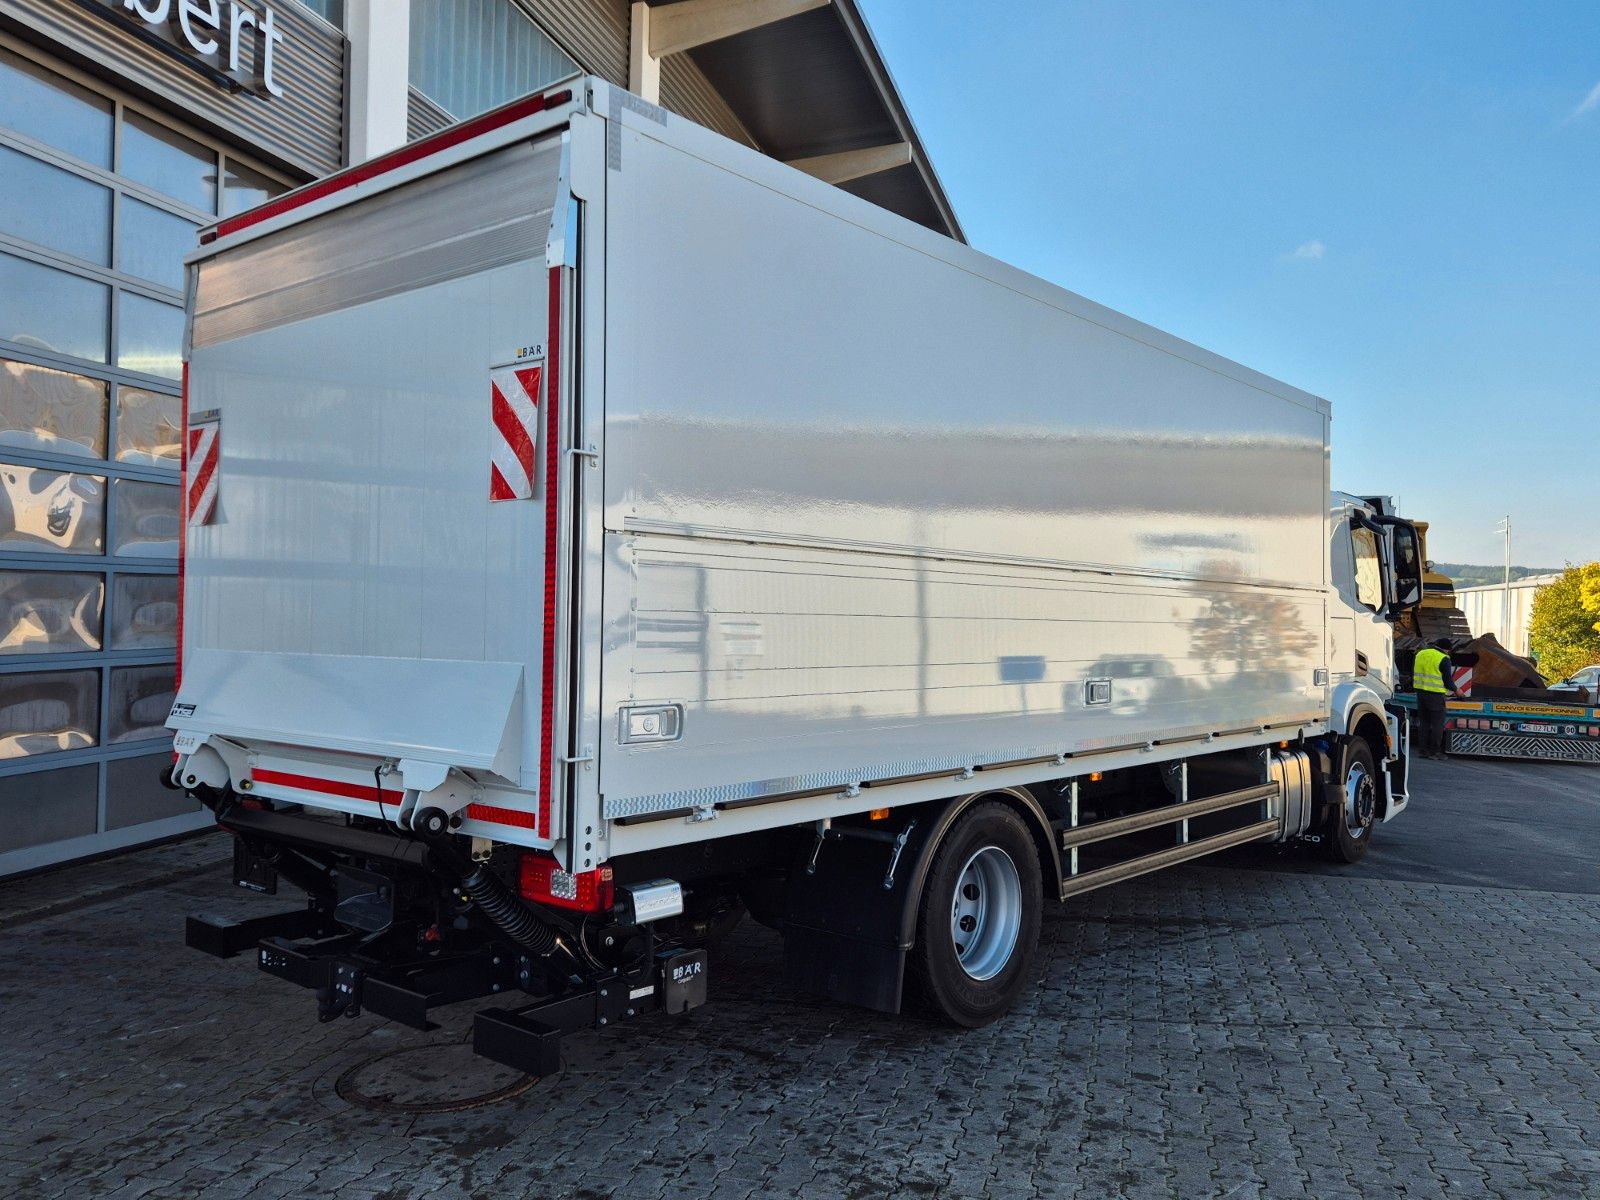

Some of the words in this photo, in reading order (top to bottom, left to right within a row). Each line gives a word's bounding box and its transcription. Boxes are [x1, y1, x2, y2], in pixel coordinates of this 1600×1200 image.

[1499, 722, 1509, 730] 70
[1566, 726, 1575, 734] 90
[1481, 747, 1521, 755] LONG
[1526, 751, 1592, 760] VEHICLE
[678, 961, 702, 978] BÄR
